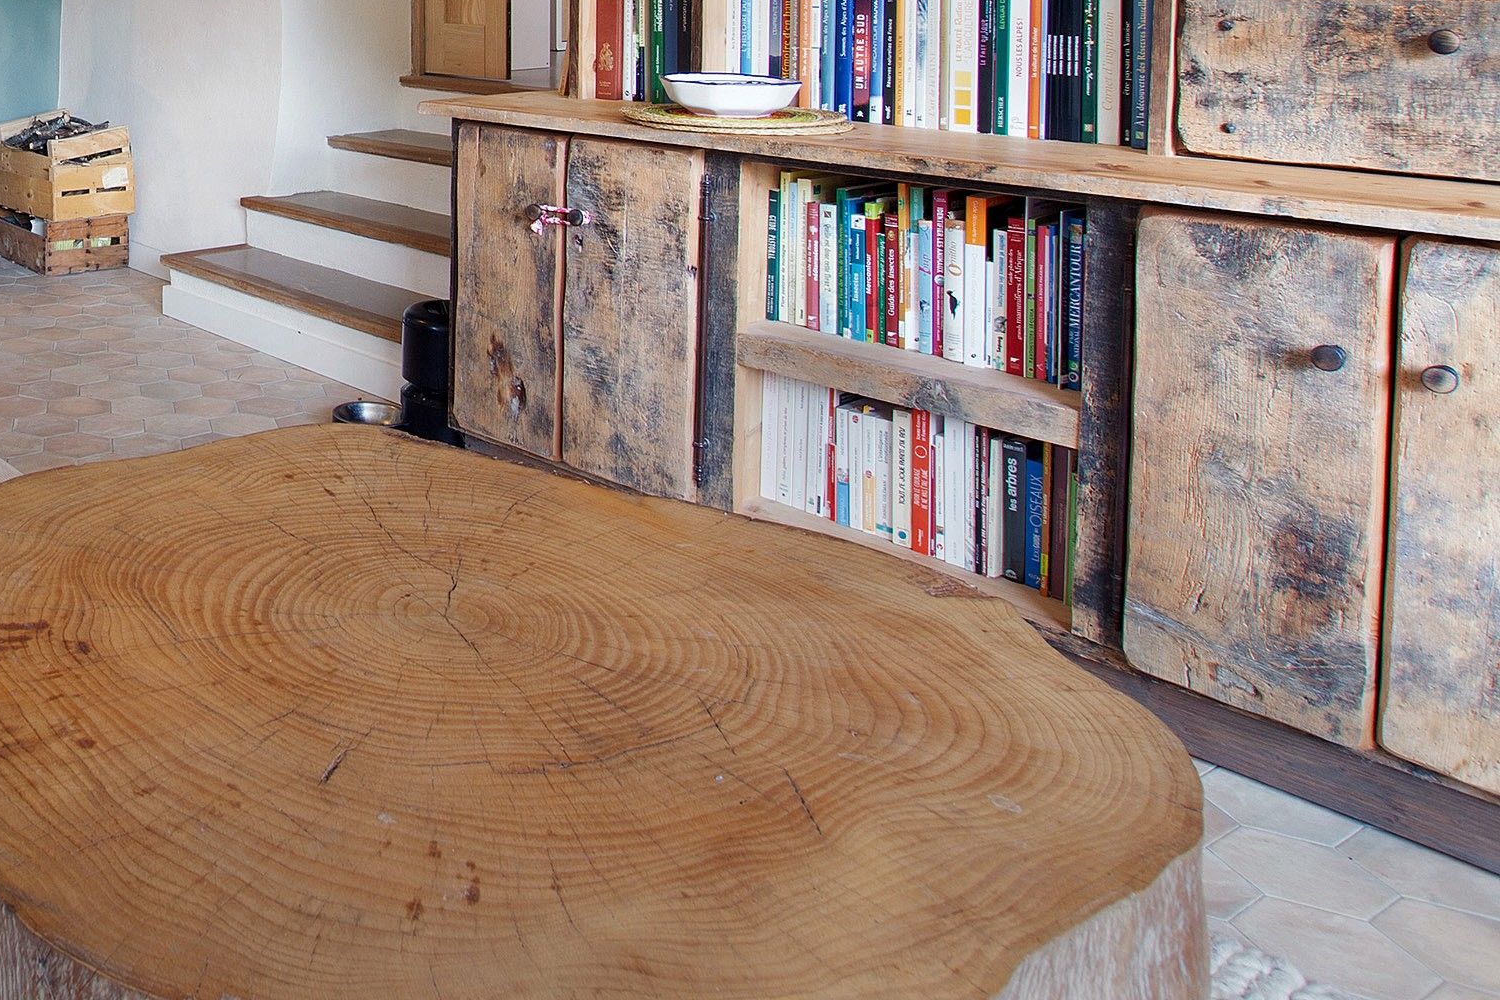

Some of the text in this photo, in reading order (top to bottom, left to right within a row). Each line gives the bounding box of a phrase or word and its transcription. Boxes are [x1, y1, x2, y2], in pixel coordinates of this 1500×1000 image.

[855, 14, 866, 90] UN AUTRE SUD
[1102, 12, 1116, 111] Carnet d'inspiration
[1137, 31, 1147, 61] Réserves
[1137, 63, 1146, 74] des
[1136, 74, 1146, 112] découverte
[936, 206, 944, 274] IDENTIFIER LES ANIMAUX
[947, 240, 962, 278] Ornitho
[1014, 250, 1023, 272] d'Afrique
[888, 248, 896, 316] Guide des insectes
[1014, 272, 1023, 324] mammifères
[1070, 244, 1082, 328] MERCANTOUR
[1006, 458, 1018, 497] arbres
[1009, 498, 1018, 512] les
[1029, 474, 1042, 527] OISEAUX
